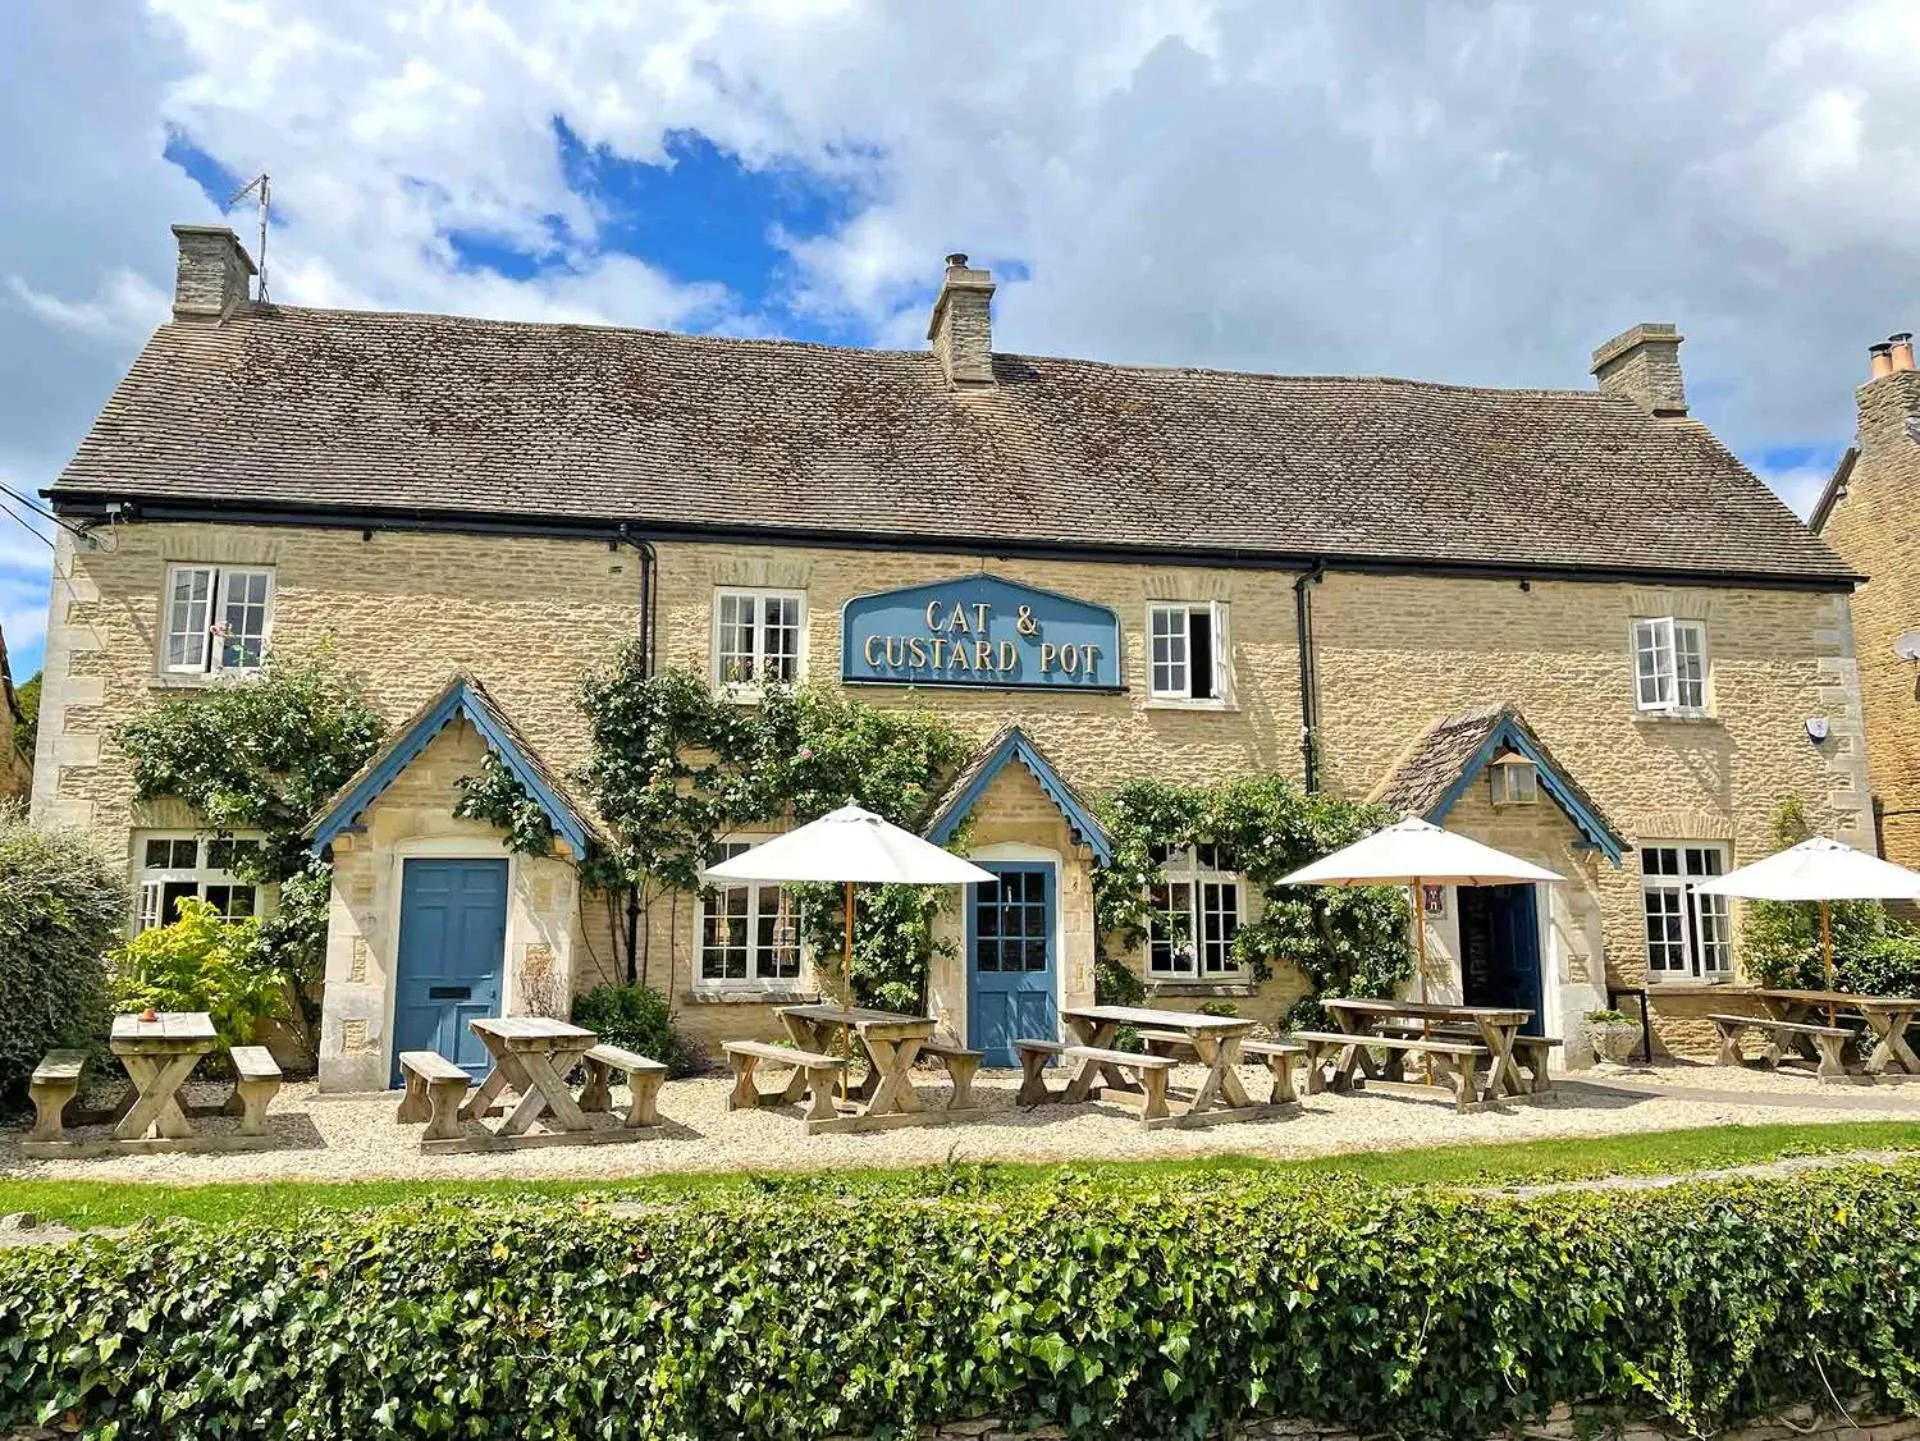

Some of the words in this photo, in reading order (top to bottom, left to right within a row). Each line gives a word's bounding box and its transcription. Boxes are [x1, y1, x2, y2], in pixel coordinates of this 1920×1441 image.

[926, 600, 991, 633] CAT
[1016, 604, 1038, 636] &
[864, 635, 1017, 672] CUSTARD
[1040, 643, 1099, 674] POT
